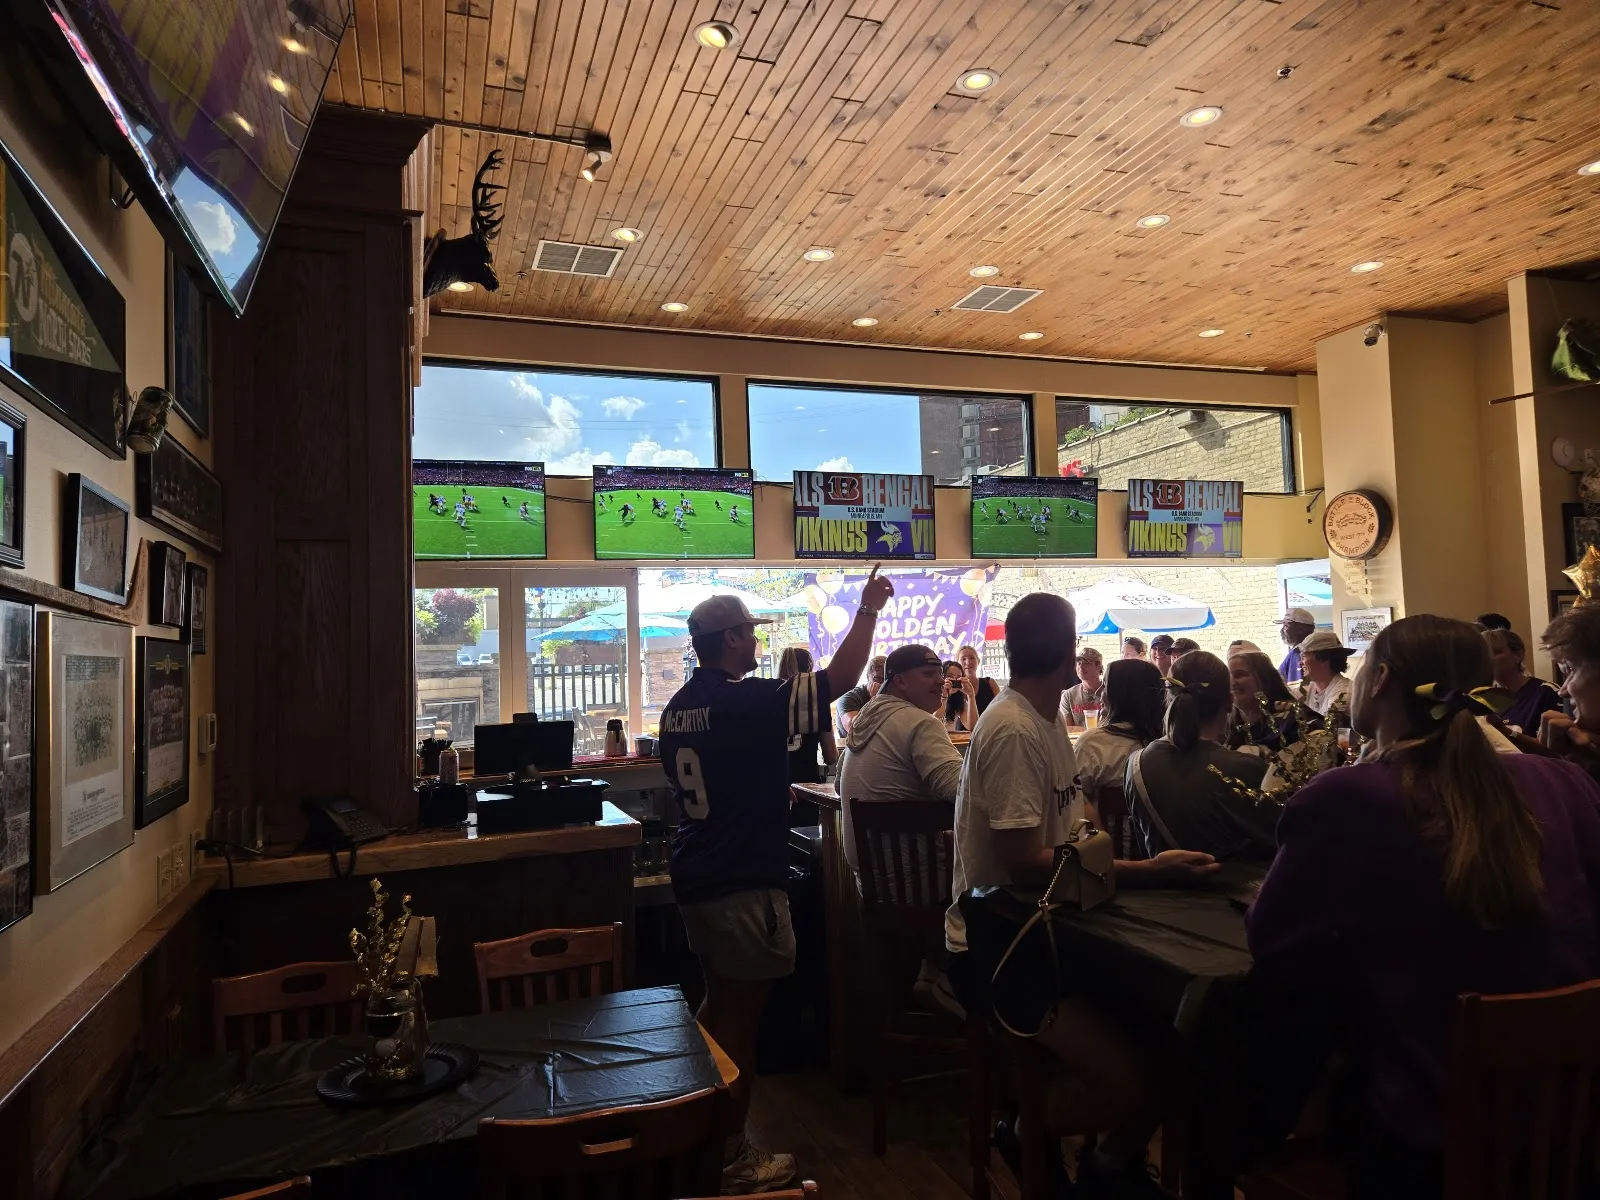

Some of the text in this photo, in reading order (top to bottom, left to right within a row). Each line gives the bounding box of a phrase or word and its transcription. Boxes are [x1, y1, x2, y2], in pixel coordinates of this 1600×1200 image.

[862, 474, 934, 510] BENGAL
[1328, 498, 1347, 527] BATTLE
[1355, 497, 1375, 520] BLOCK
[1336, 538, 1370, 554] CHAMPION
[878, 593, 944, 618] APPY
[876, 613, 957, 640] OLDEN
[874, 631, 968, 657] RTDAY
[675, 747, 711, 820] 9
